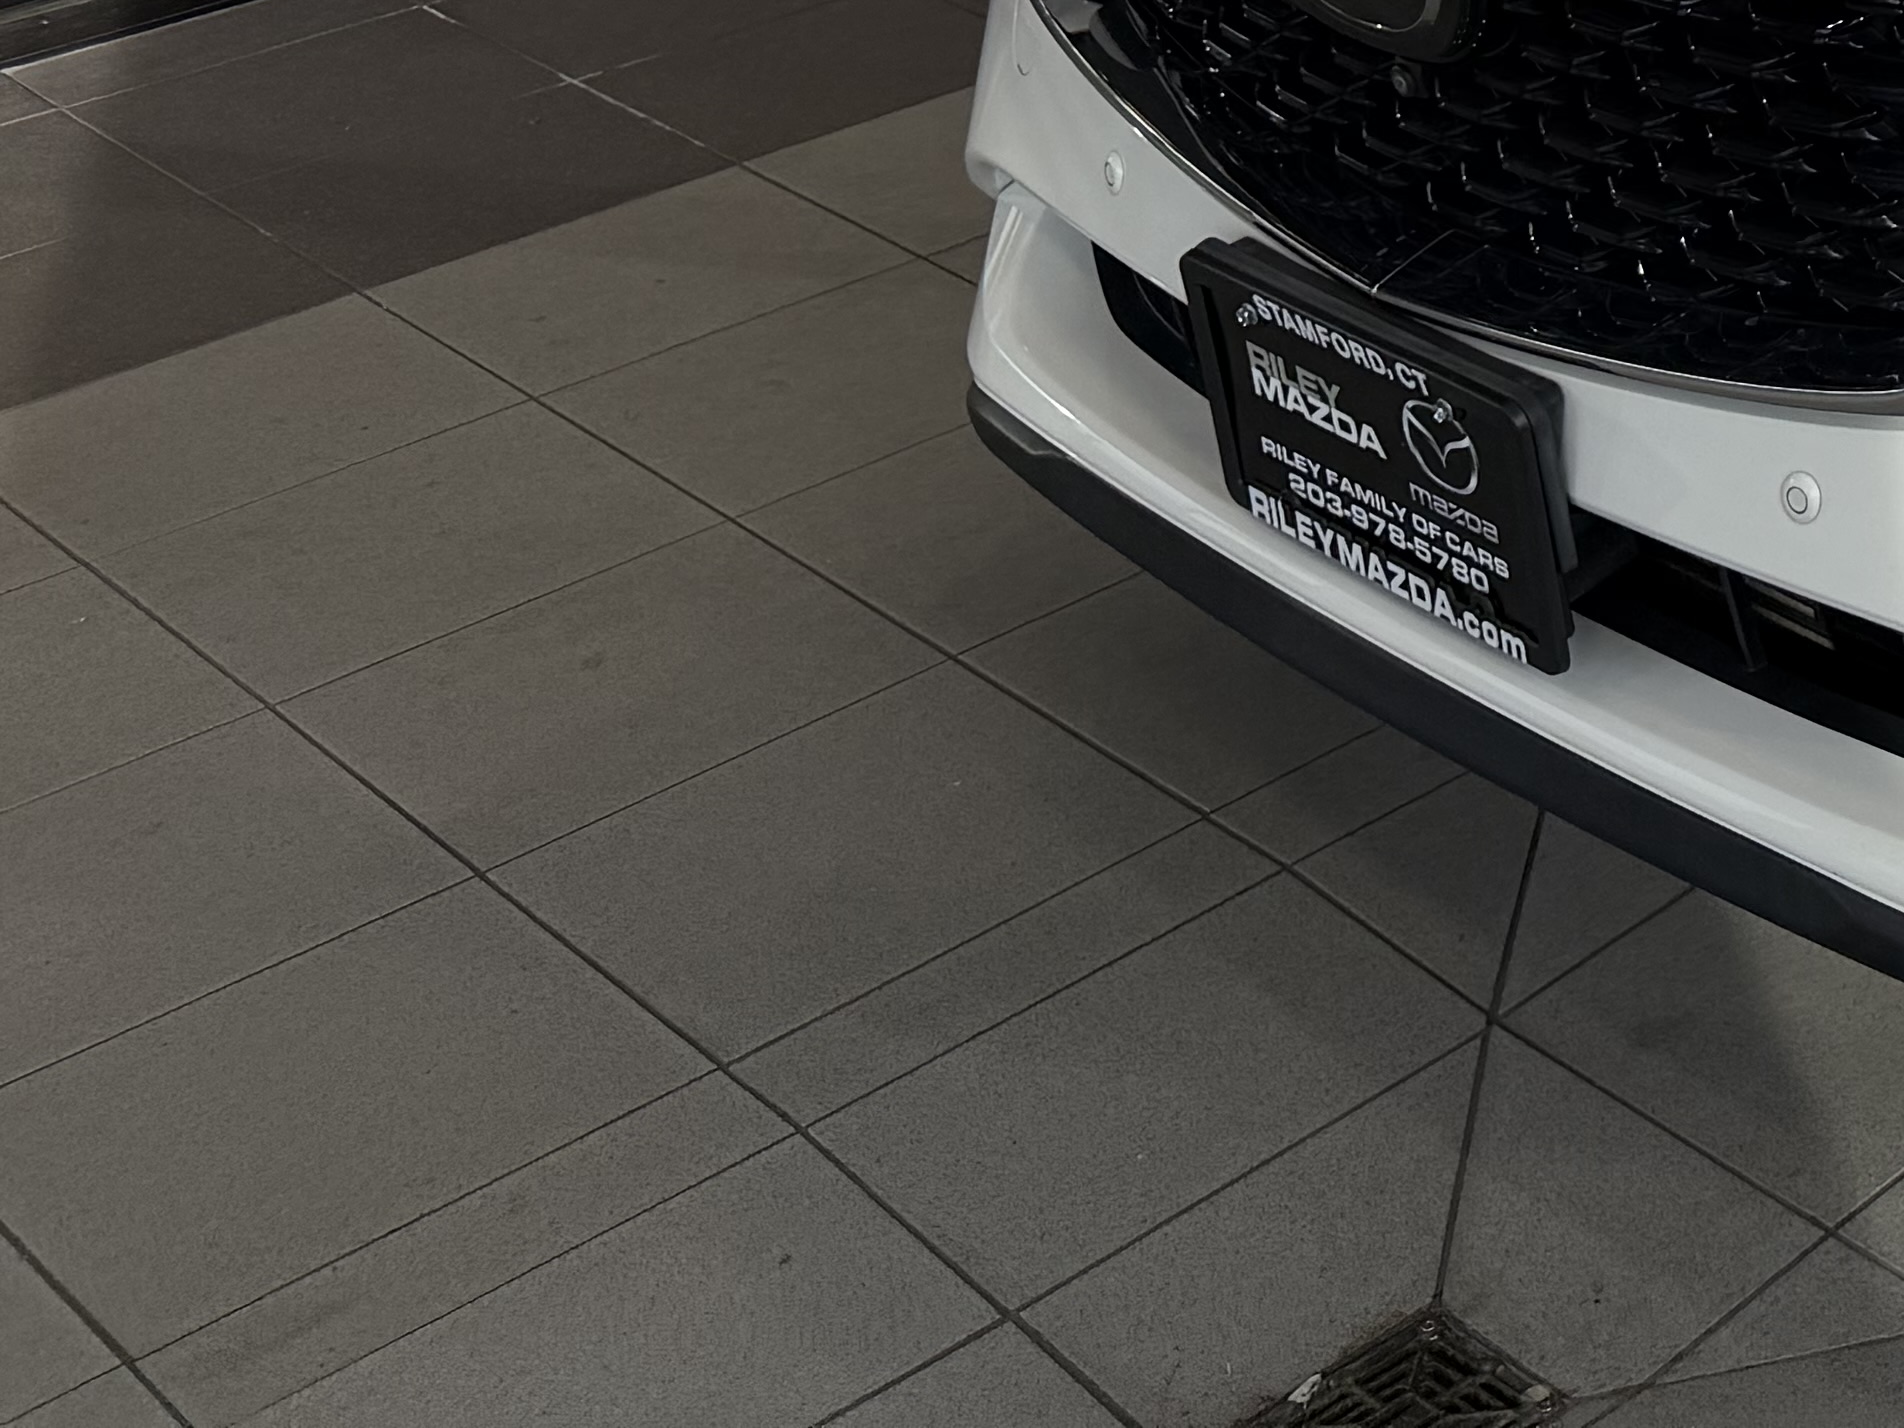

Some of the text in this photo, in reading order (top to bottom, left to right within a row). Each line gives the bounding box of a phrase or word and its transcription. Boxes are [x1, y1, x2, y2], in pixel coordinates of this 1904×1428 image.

[1246, 339, 1341, 409] RILEY
[1252, 293, 1429, 397] STAMFORD, CT
[1251, 365, 1388, 461] MAZDA
[1260, 435, 1510, 580] RILEY FAMILY OF CARS
[1287, 471, 1490, 595] 203-978-5780
[1247, 484, 1528, 665] RILEYMAZDA.com
